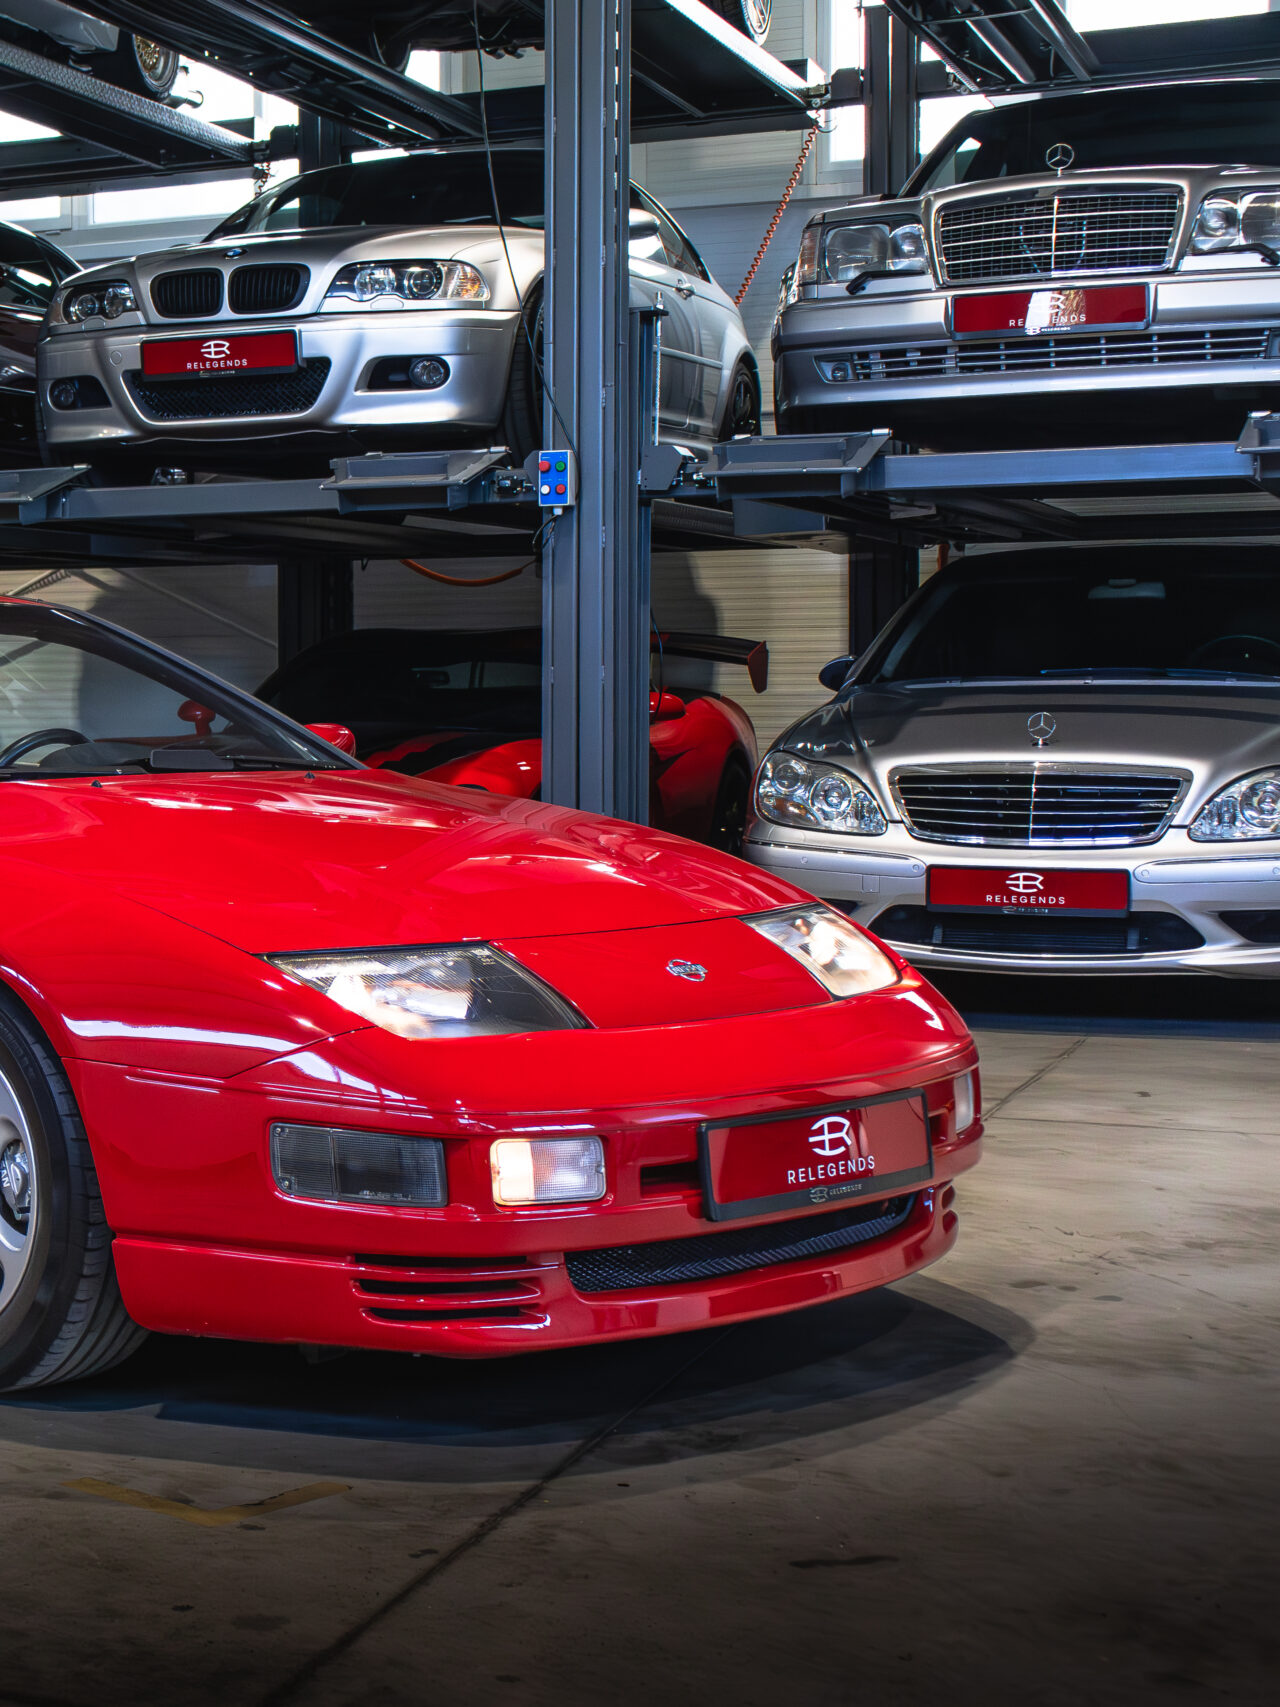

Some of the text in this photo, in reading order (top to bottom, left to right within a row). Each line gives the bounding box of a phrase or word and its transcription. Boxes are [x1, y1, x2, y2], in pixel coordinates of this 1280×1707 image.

[1009, 314, 1087, 327] REENDS
[186, 358, 248, 370] RELEGENDS
[985, 894, 1066, 905] RELEGENDS
[787, 1155, 876, 1184] RELEGENDS
